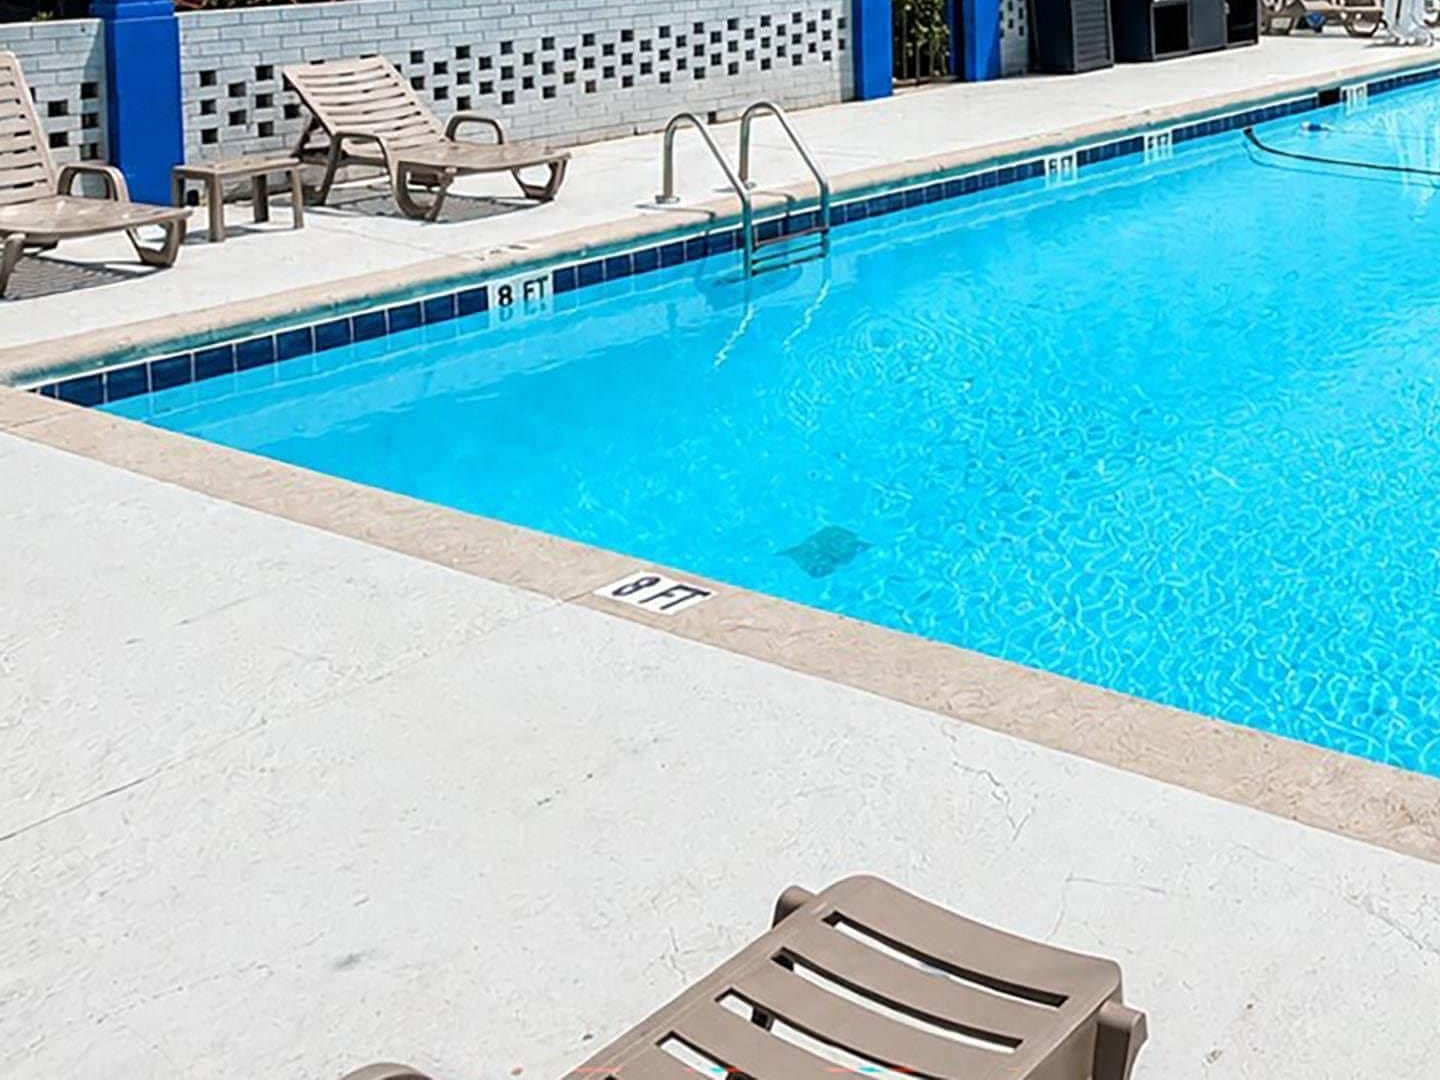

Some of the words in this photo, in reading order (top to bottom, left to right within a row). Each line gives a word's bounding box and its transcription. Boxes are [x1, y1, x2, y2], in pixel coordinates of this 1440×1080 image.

[497, 284, 513, 308] 8
[523, 274, 549, 303] FT
[611, 575, 662, 597] 8
[638, 583, 712, 611] FT
